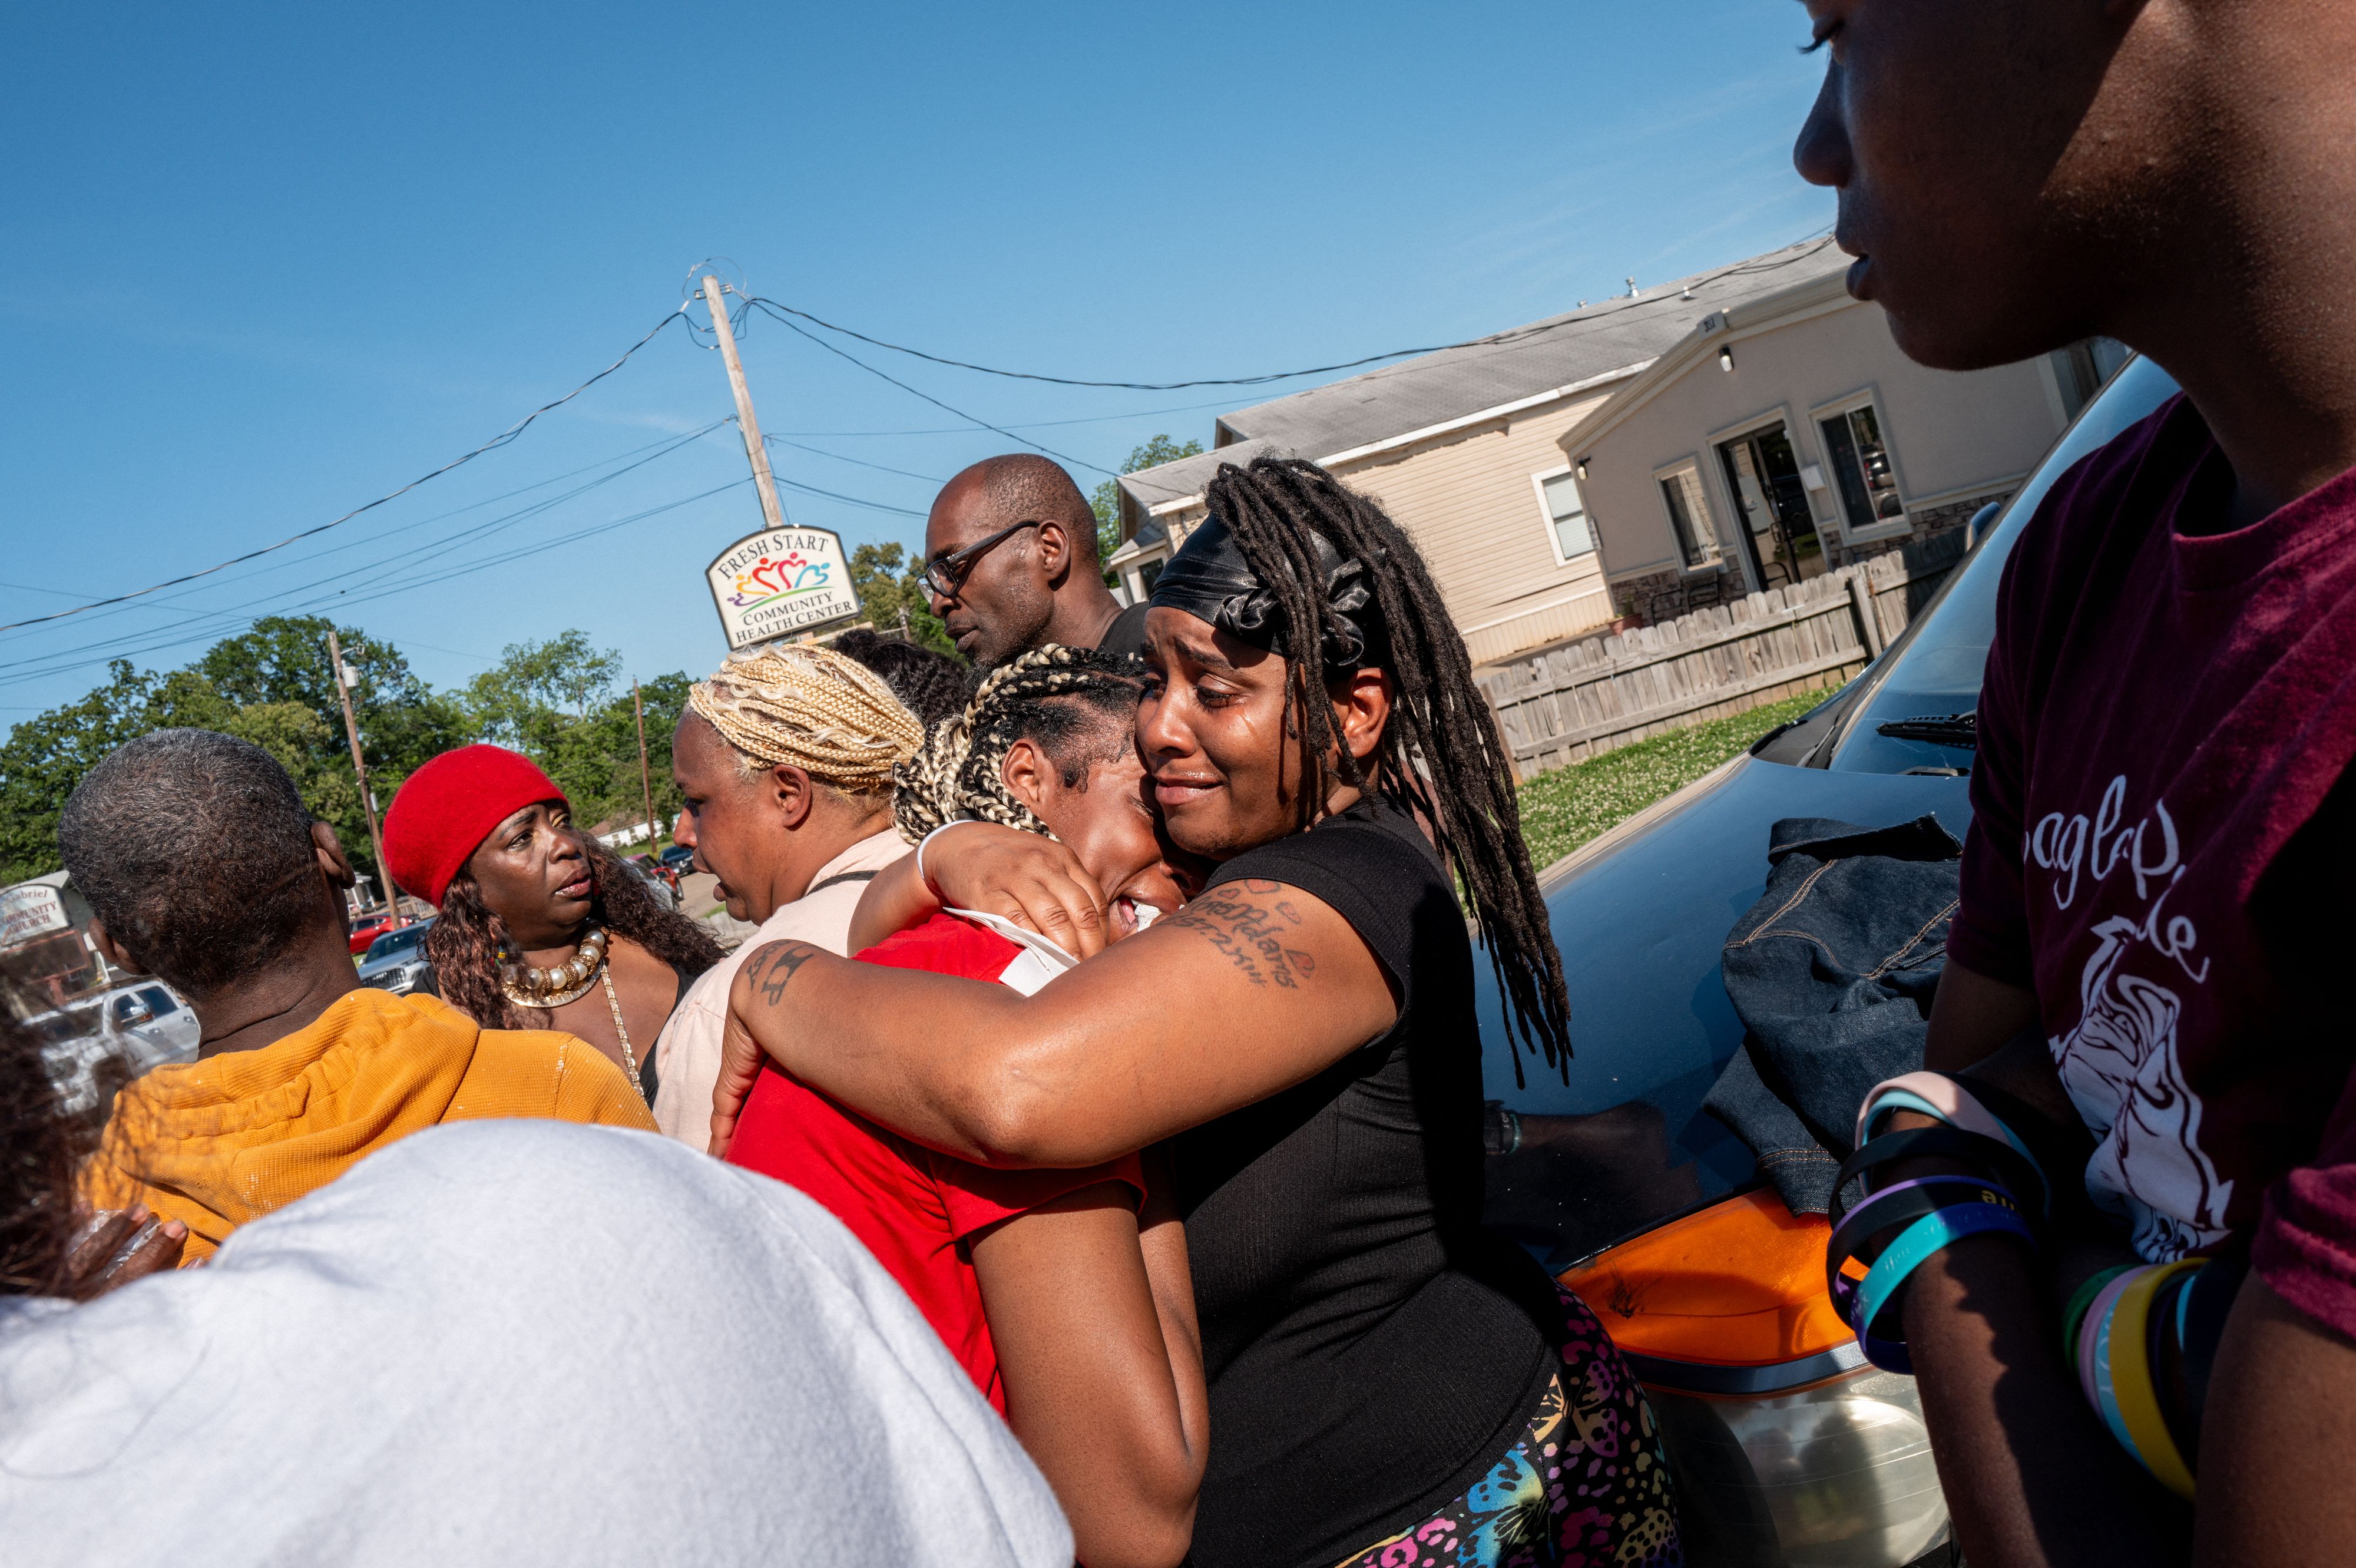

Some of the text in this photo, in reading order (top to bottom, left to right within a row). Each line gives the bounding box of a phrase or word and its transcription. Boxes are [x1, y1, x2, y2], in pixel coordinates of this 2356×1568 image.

[717, 534, 829, 580] FRESH START
[736, 600, 853, 643] HEALTH CENTER
[743, 591, 833, 626] COMMUNITY
[1, 901, 57, 925] OMMUNITY
